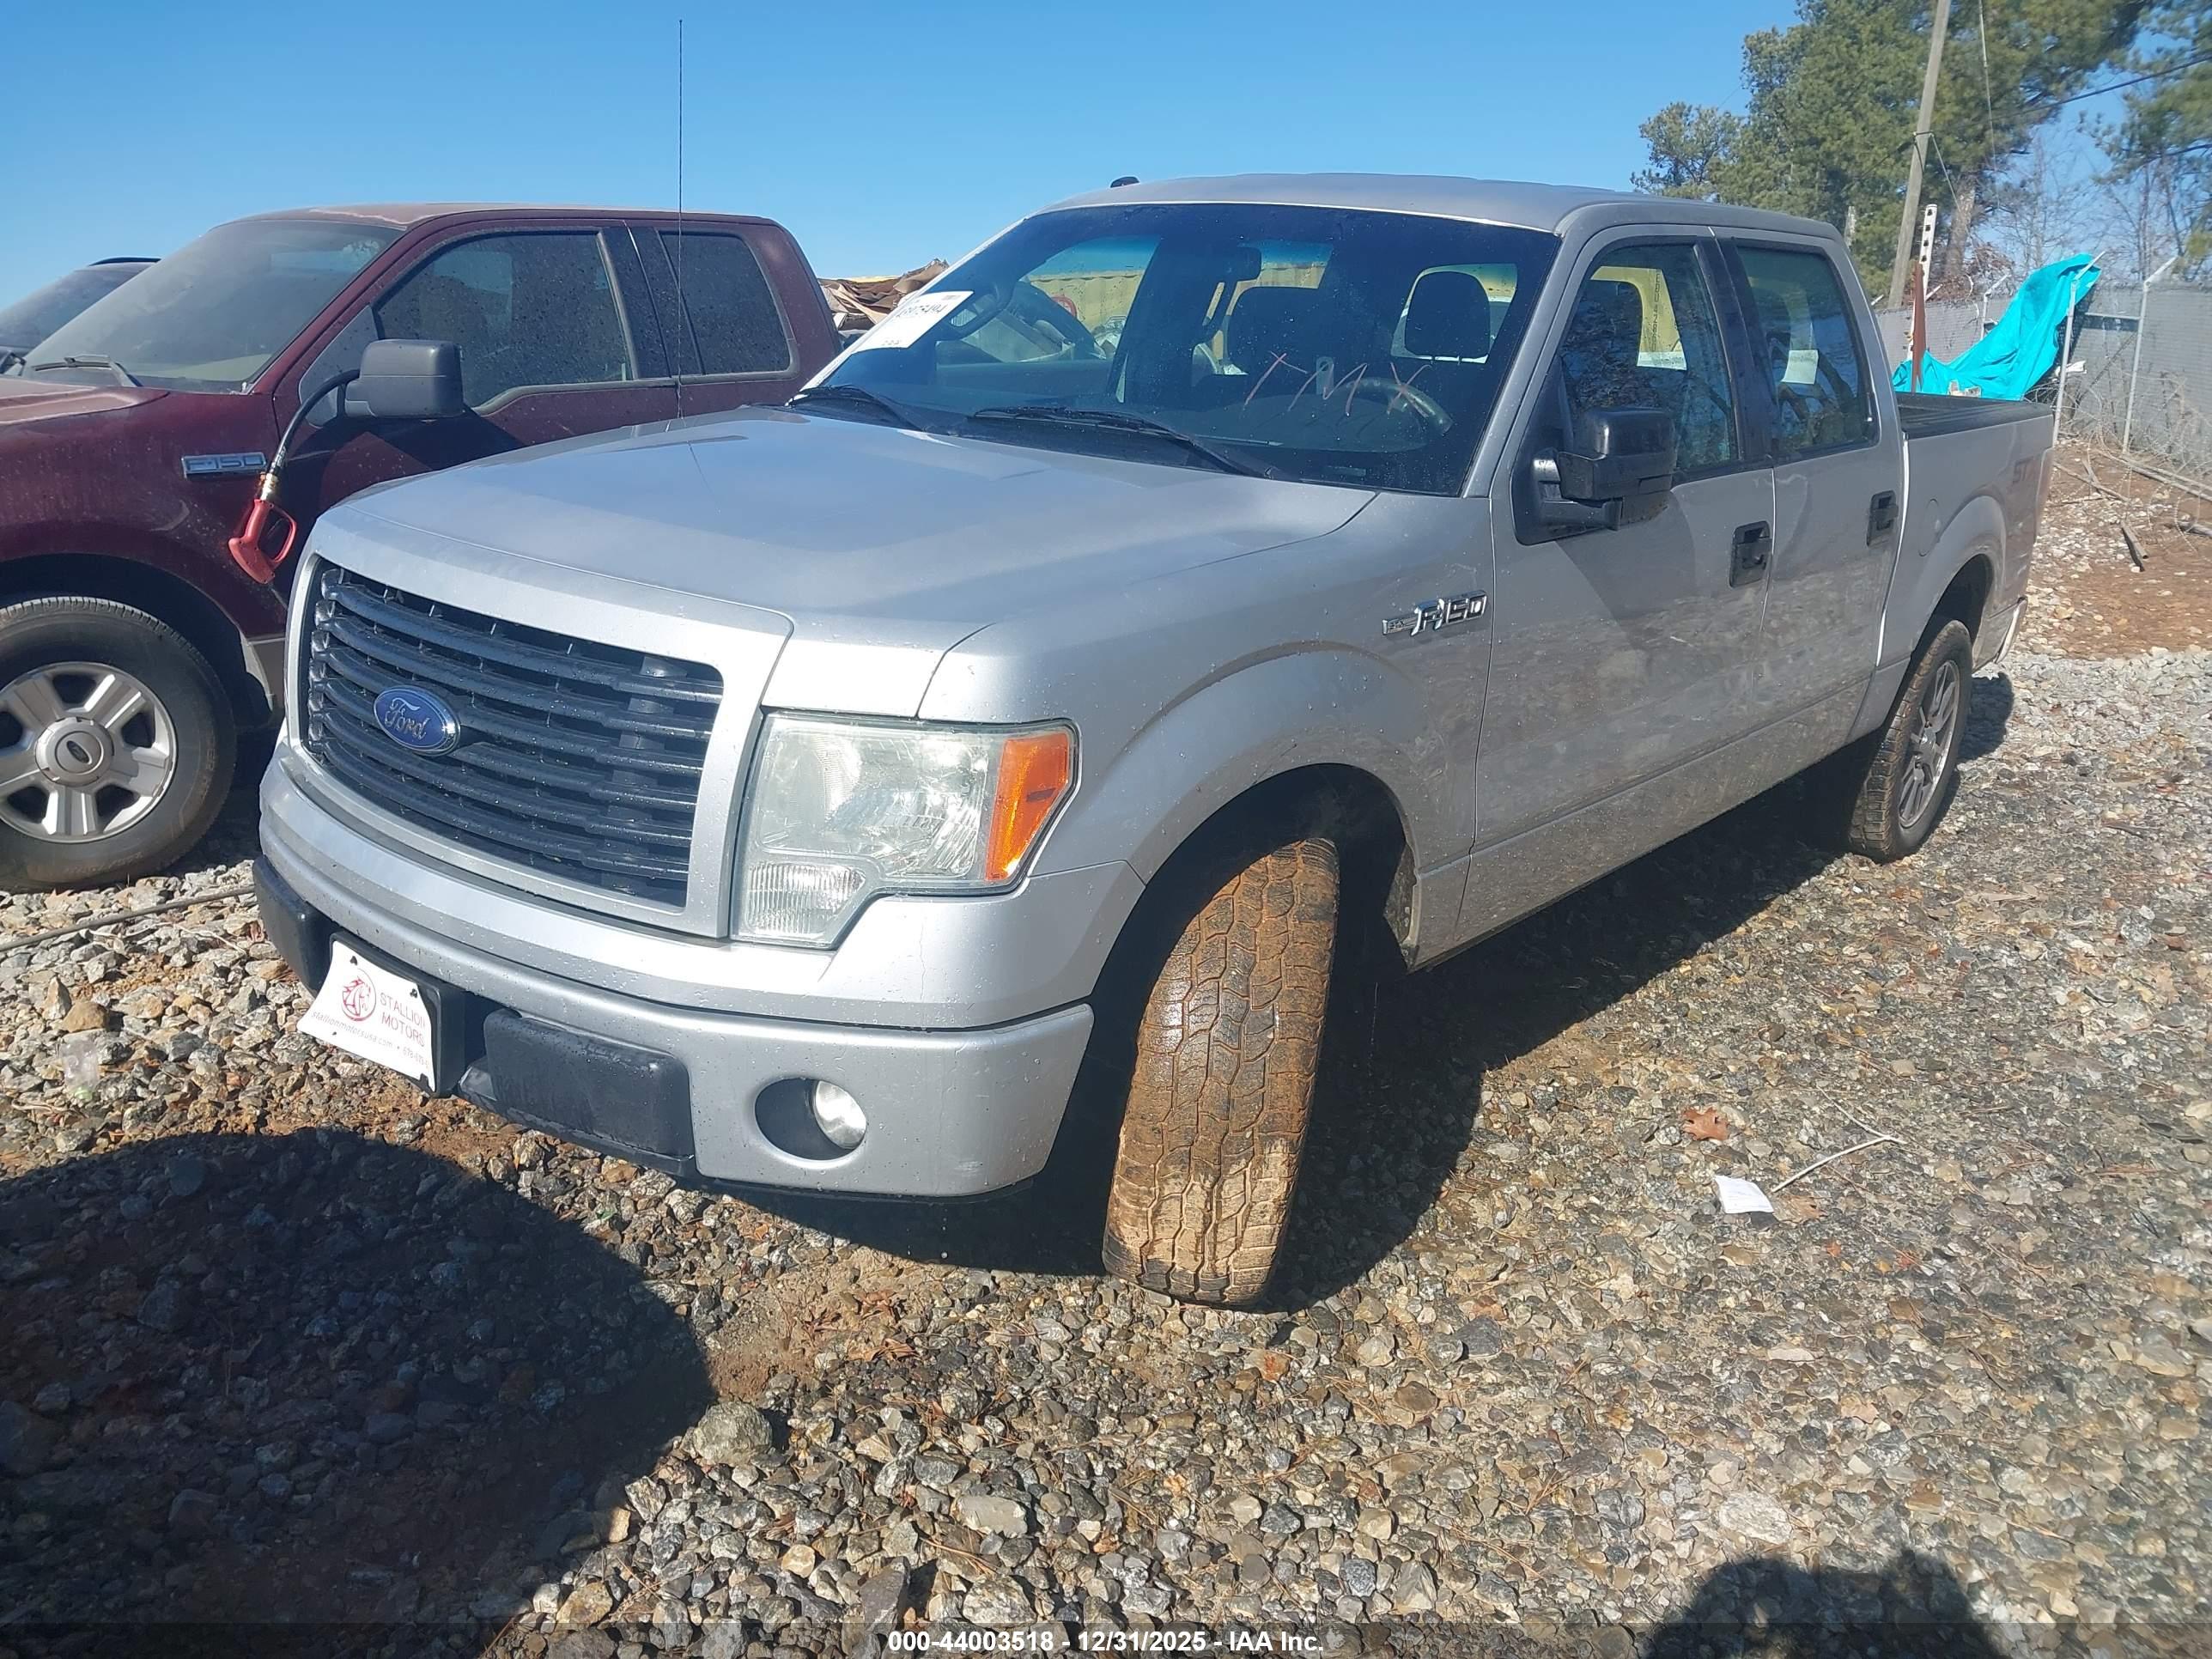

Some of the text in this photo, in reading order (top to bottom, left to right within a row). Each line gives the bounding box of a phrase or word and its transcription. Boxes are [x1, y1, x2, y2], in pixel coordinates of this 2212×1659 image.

[384, 697, 430, 740] Ford
[380, 991, 426, 1028] STALLION
[381, 1011, 425, 1047] MOTORS
